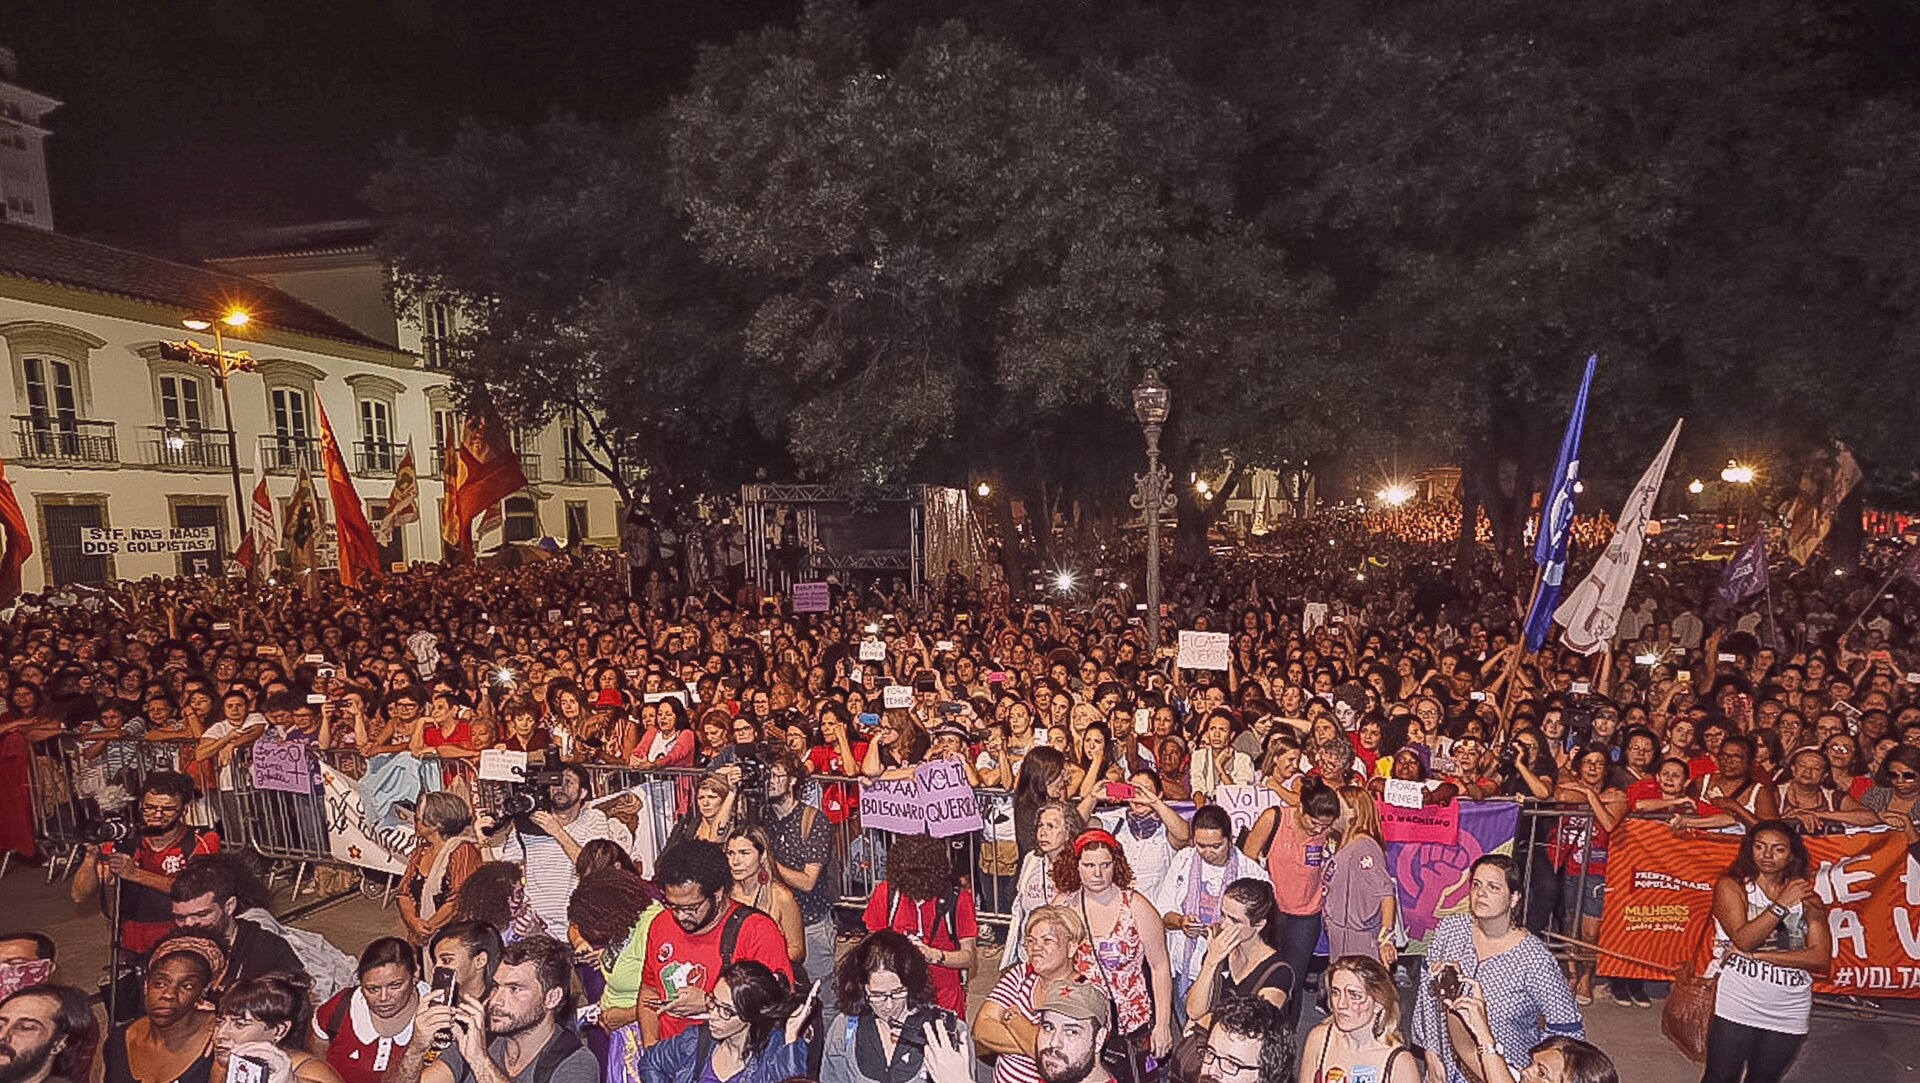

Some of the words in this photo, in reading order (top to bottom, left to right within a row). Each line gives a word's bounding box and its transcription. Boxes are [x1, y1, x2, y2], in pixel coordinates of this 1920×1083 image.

[131, 528, 162, 540] NAS
[169, 527, 210, 540] MAOS
[84, 541, 119, 553] DOS
[127, 540, 215, 553] GOLPISTAS?
[1389, 780, 1418, 792] FORA
[861, 797, 925, 820] BOLSONARO
